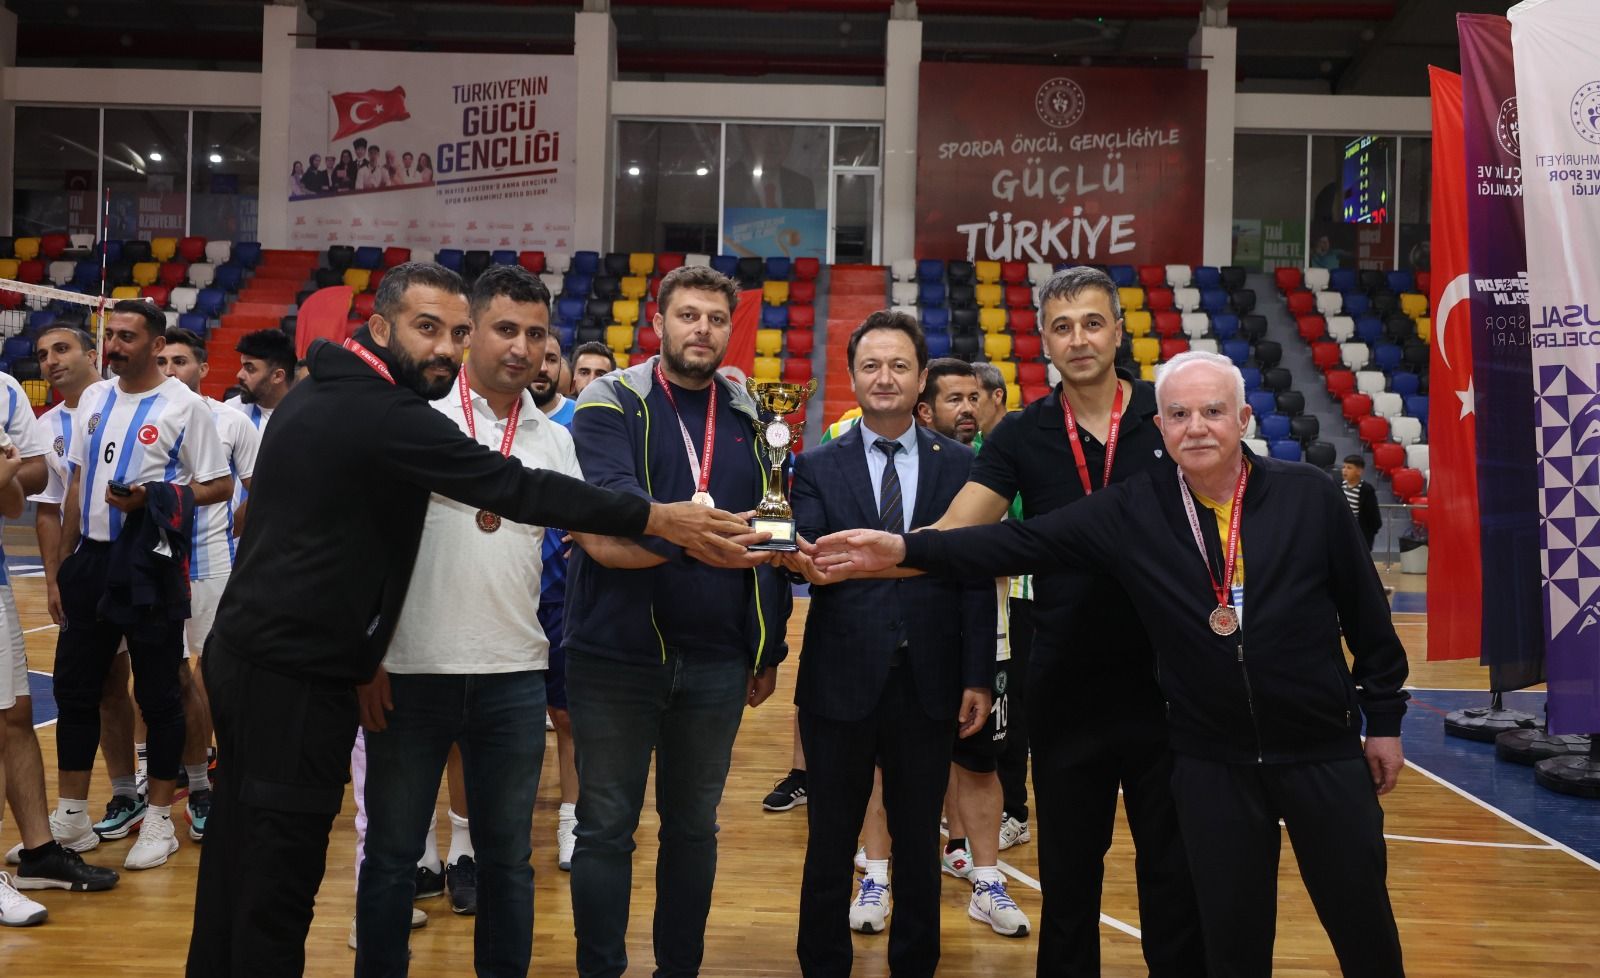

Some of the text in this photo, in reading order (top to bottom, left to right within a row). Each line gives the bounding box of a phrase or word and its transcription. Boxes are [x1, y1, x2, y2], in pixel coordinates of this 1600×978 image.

[452, 75, 549, 104] TÜRKİYE'NİN
[463, 101, 536, 137] GÜCÜ
[436, 129, 560, 172] GENÇLİĞİ
[938, 139, 1005, 160] SPORDA
[1070, 126, 1180, 153] GENÇLİĞİYLE
[991, 152, 1125, 203] GÜÇLÜ
[956, 205, 1137, 265] TÜRKİYE
[104, 441, 116, 464] 6
[990, 693, 1008, 731] 10
